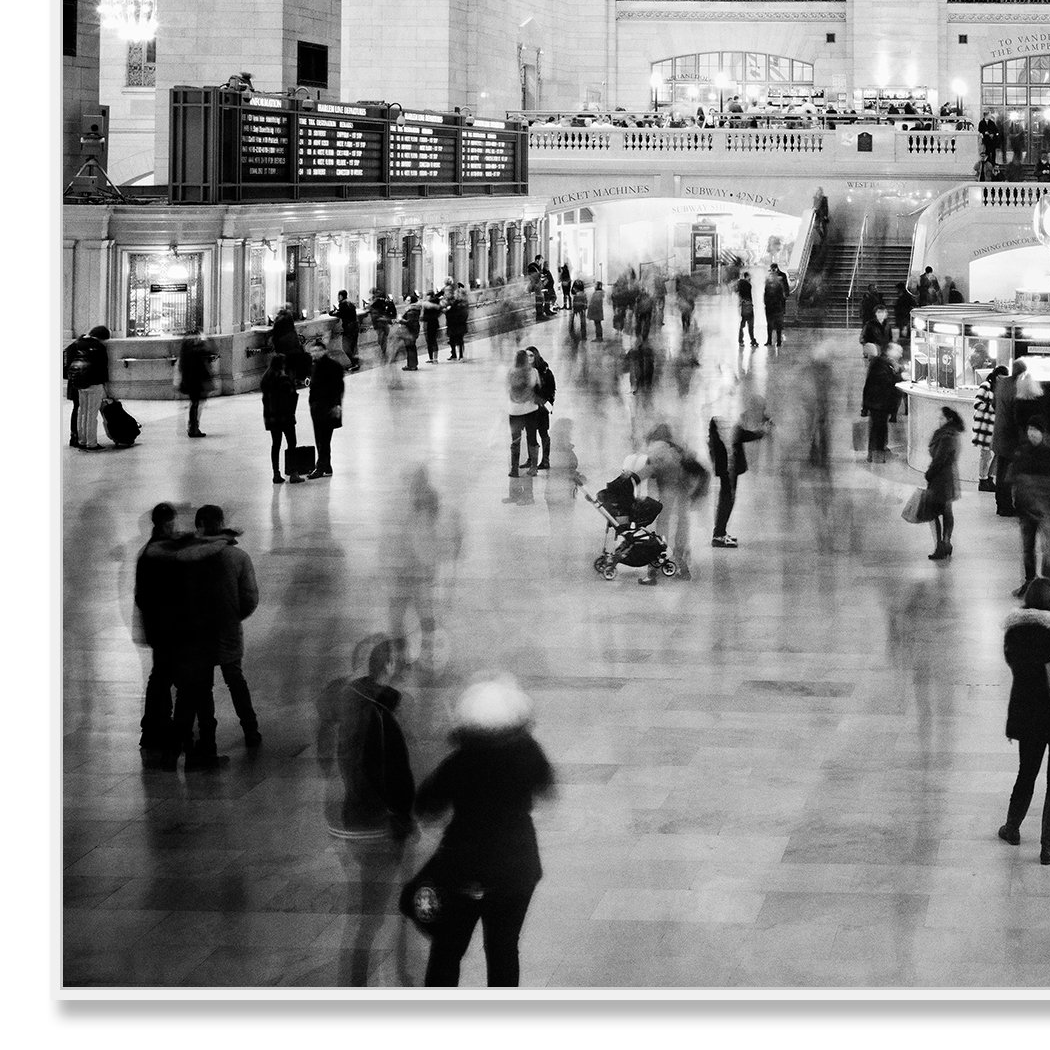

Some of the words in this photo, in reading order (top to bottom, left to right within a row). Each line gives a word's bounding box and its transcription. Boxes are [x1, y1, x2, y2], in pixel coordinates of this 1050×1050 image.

[998, 38, 1012, 47] TO
[990, 47, 1013, 59] THE
[846, 181, 869, 189] WEST
[552, 190, 591, 206] TICKET
[593, 184, 651, 198] MACHINES
[684, 186, 728, 198] SUBWAY
[735, 190, 764, 204] 42ND
[765, 196, 779, 208] ST
[973, 243, 1001, 257] DINING
